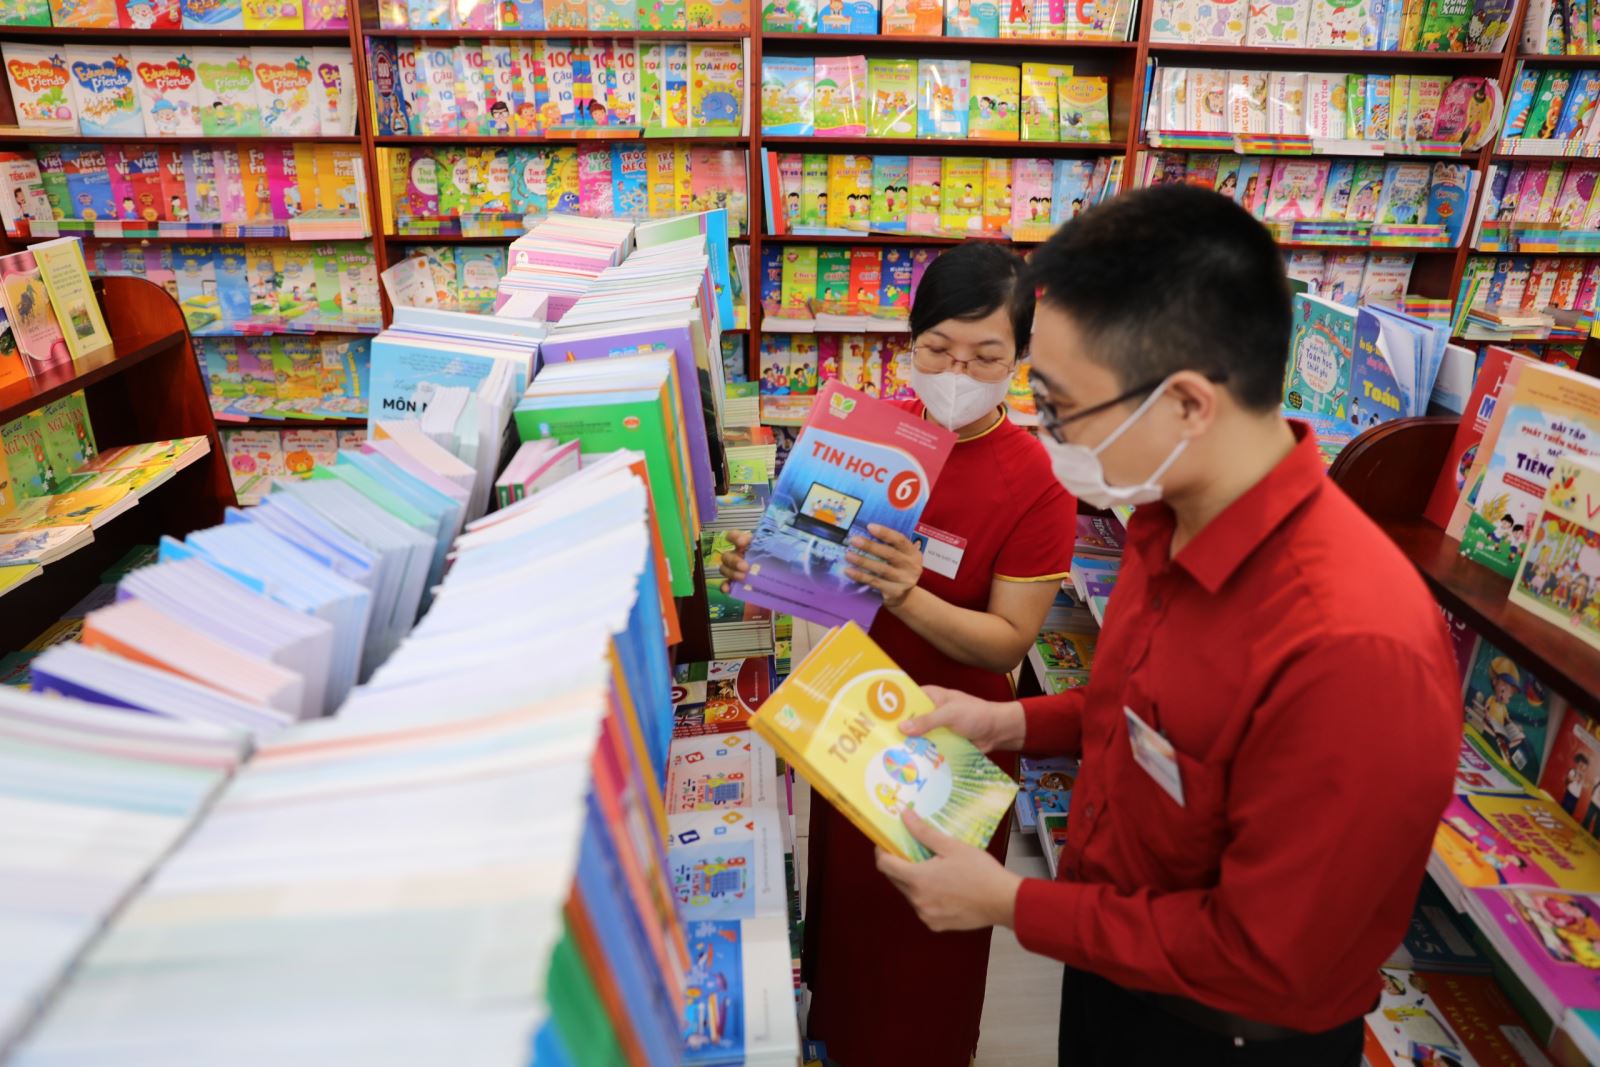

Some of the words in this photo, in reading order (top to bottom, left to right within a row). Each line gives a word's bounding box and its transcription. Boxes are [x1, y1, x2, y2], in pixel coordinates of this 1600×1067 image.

[382, 396, 417, 413] MÔN
[1362, 380, 1400, 412] Toán
[812, 440, 845, 467] TIN
[844, 454, 889, 483] HỌC
[894, 478, 918, 501] 6
[877, 681, 899, 714] 6
[828, 711, 877, 765] TOÁN
